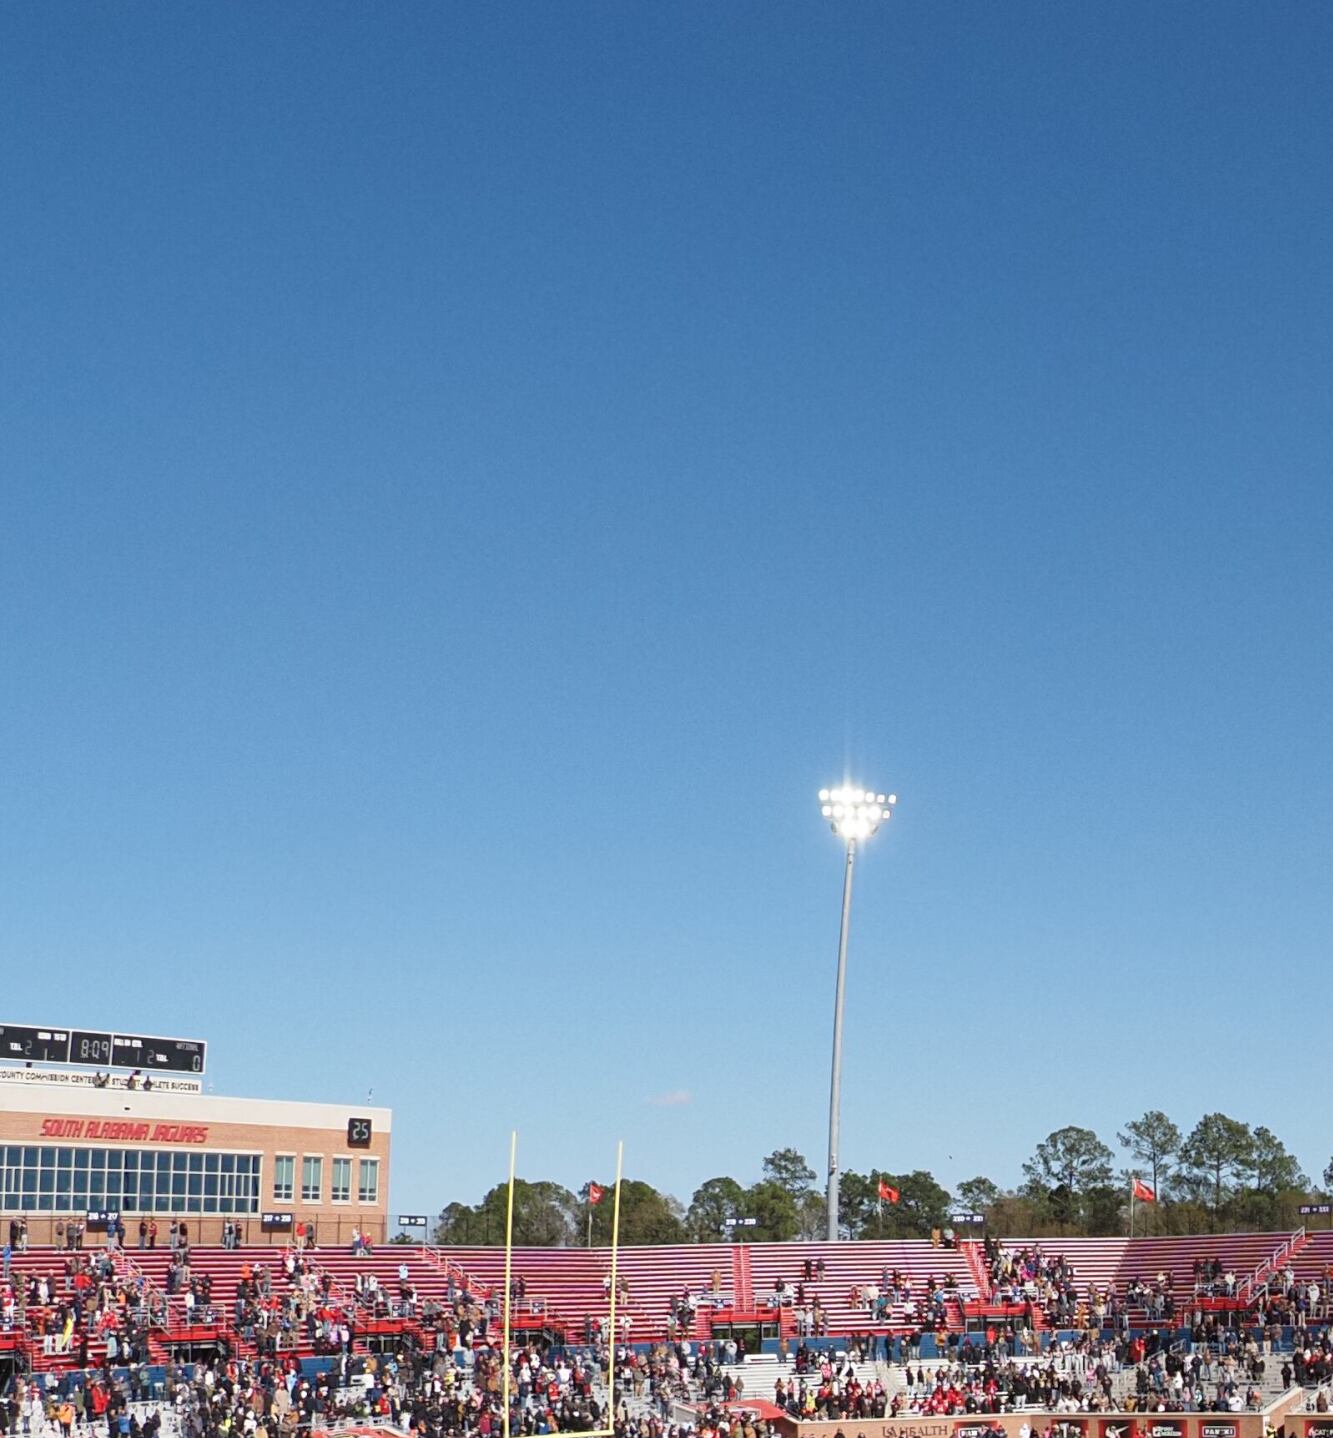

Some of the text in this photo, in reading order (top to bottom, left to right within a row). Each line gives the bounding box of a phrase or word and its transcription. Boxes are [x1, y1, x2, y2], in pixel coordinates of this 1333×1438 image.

[81, 1039, 109, 1059] 8:09
[192, 1055, 201, 1071] 0
[25, 1071, 69, 1082] COMMISSION
[171, 1081, 199, 1092] SUCCESS
[40, 1119, 209, 1144] SOUTH ALABAMA JAGUARS
[351, 1121, 368, 1140] 25
[904, 1425, 948, 1438] HEALTH
